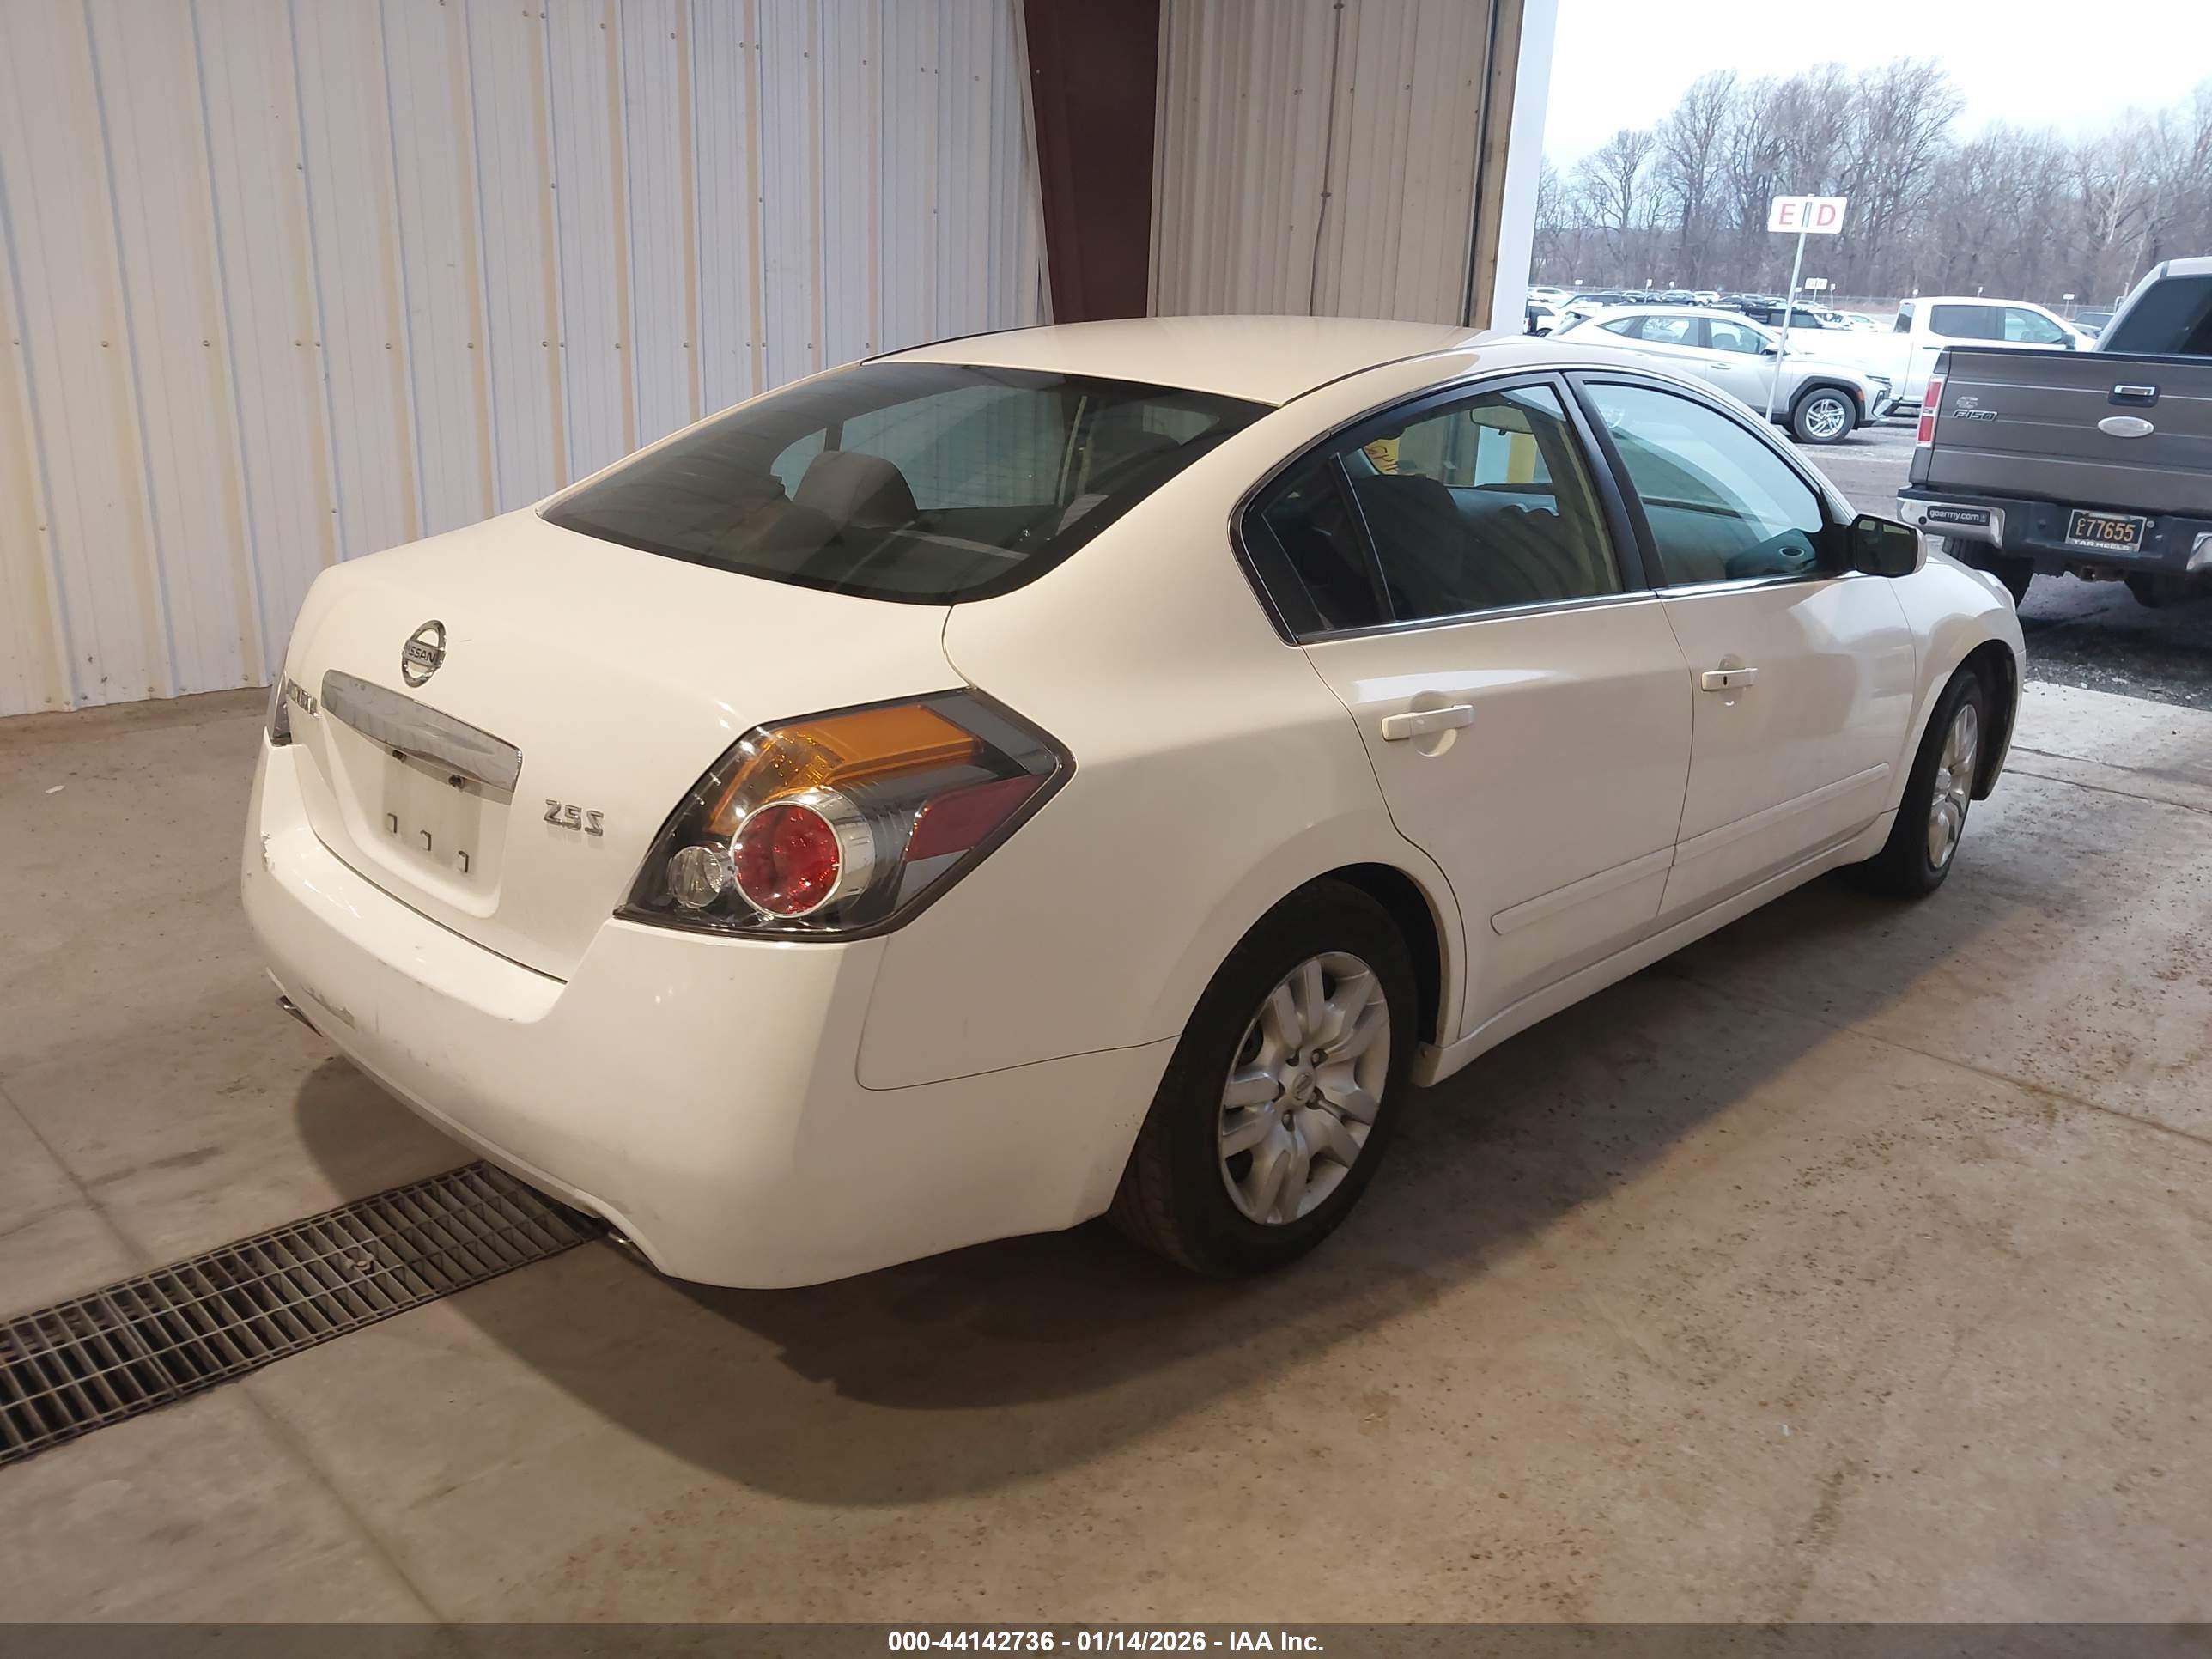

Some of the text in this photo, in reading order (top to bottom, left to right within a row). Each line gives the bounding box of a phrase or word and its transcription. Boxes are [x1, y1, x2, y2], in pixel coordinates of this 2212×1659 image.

[1778, 203, 1836, 226] E D
[1929, 509, 1979, 520] goarmy.com
[405, 643, 436, 664] SSAN
